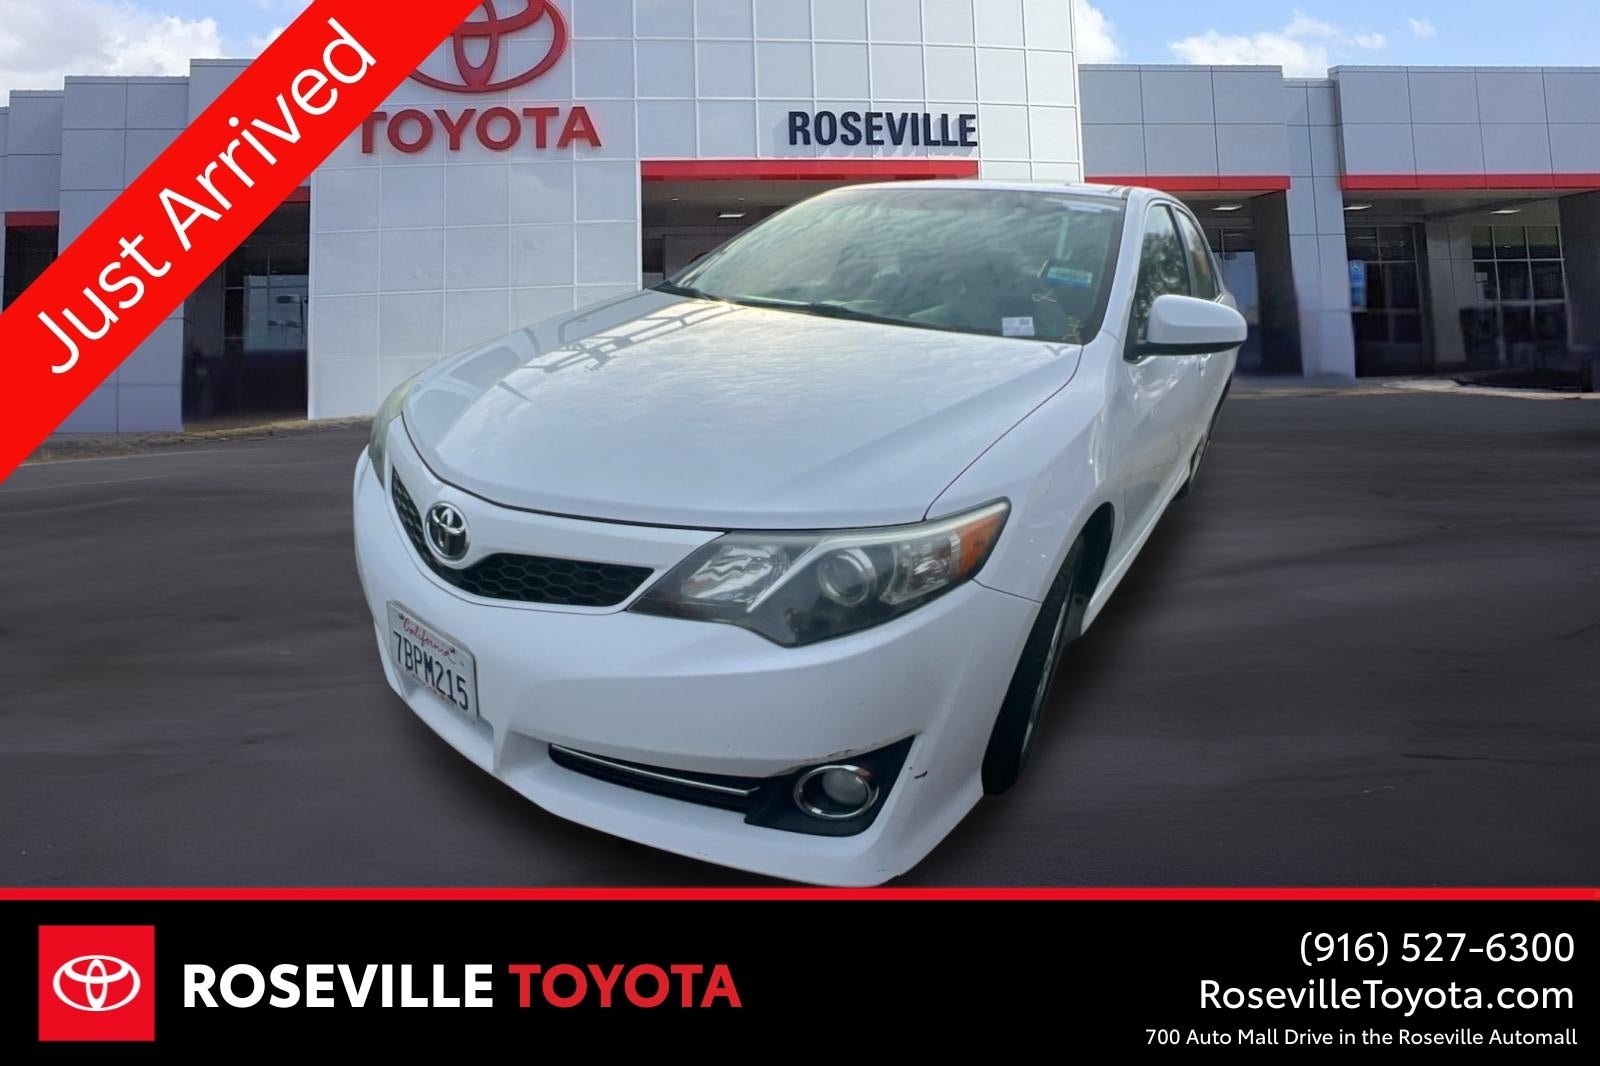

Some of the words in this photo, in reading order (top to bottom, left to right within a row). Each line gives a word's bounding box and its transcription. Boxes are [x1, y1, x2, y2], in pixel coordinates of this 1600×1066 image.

[360, 106, 602, 154] TOYOTA
[788, 110, 979, 147] ROSEVILLE
[393, 629, 469, 711] 7BPM215
